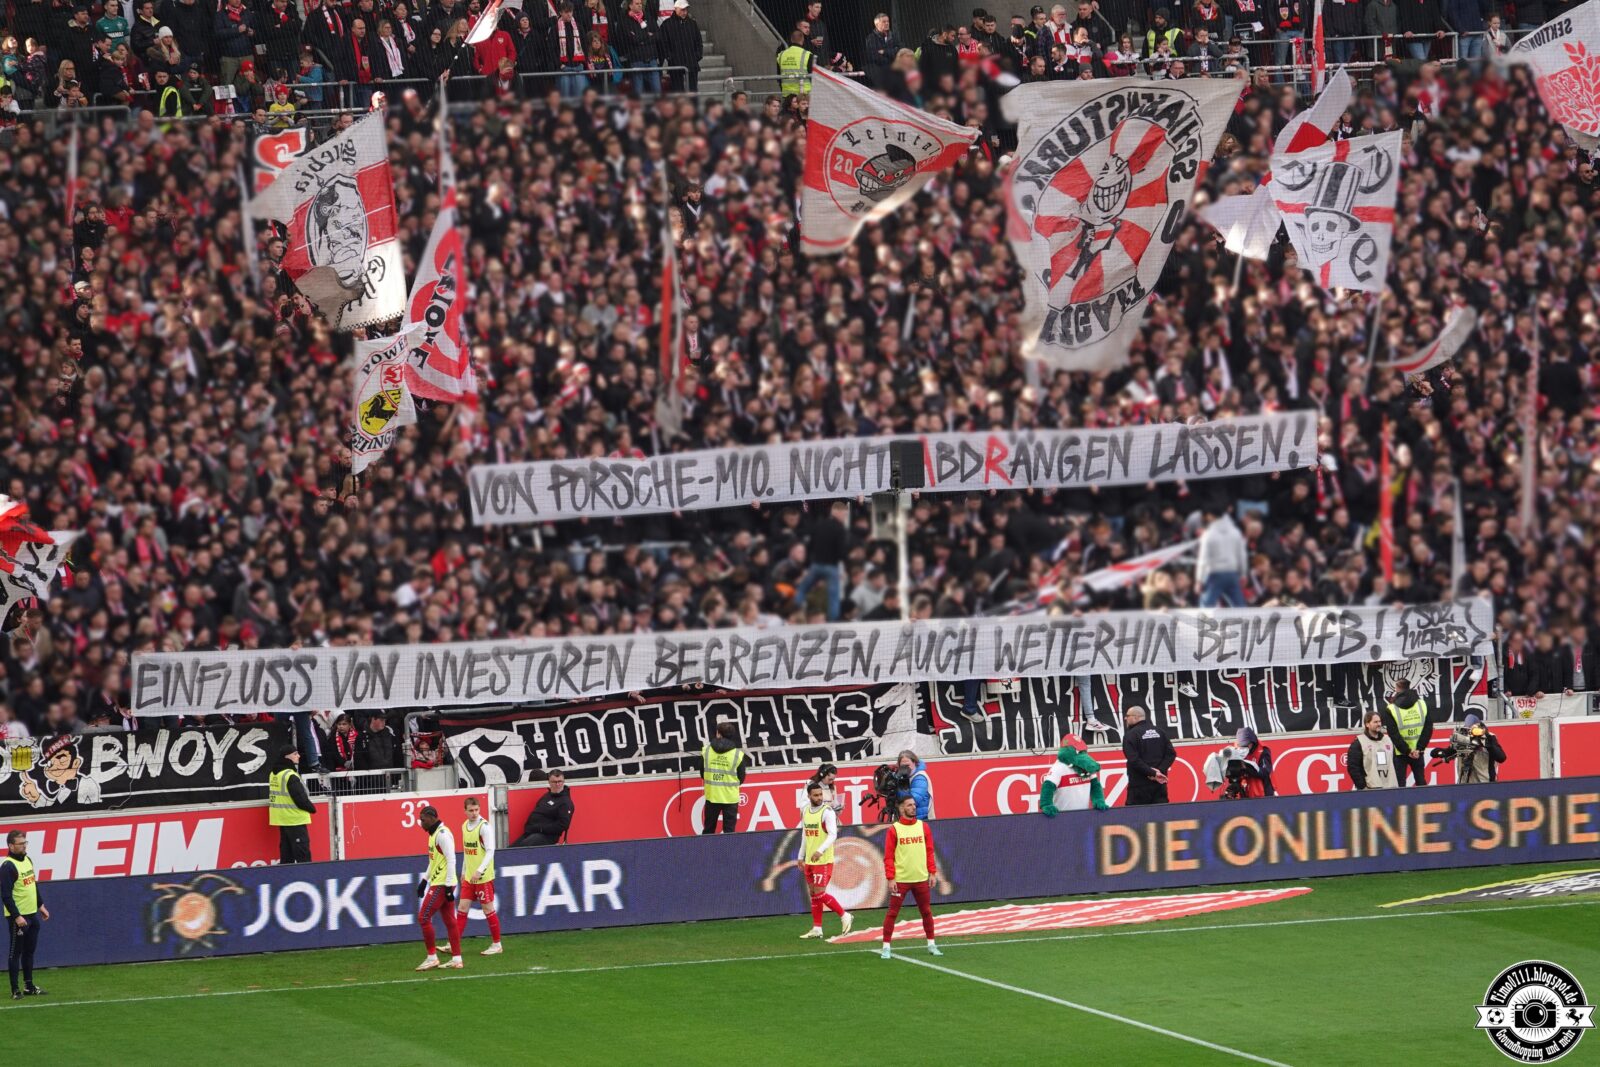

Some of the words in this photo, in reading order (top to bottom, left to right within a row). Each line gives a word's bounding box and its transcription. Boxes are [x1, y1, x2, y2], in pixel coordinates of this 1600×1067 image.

[470, 465, 538, 516] VON
[789, 442, 890, 495] NICHT
[1149, 415, 1309, 478] LASSEN!
[135, 653, 318, 710] EINFLUSS
[331, 649, 400, 709] VON
[413, 638, 635, 700] INVESTOREN
[888, 623, 978, 677] AUCH
[1192, 611, 1283, 663] BEIM
[899, 835, 924, 847] REWE
[1100, 819, 1200, 876] DIE
[1217, 802, 1452, 867] ONLINE
